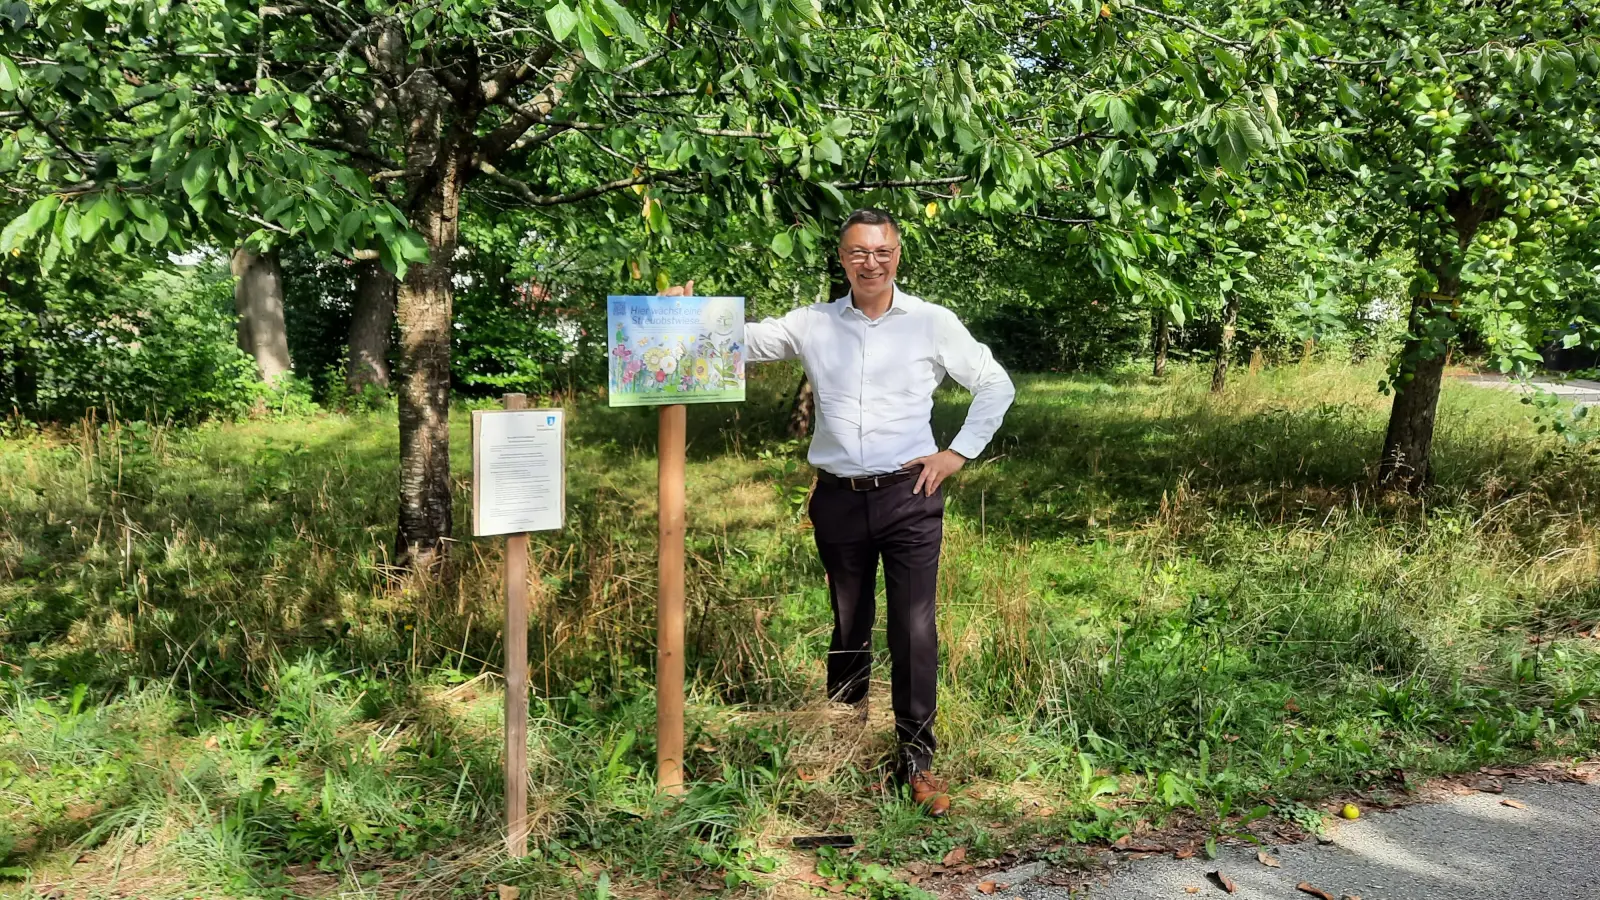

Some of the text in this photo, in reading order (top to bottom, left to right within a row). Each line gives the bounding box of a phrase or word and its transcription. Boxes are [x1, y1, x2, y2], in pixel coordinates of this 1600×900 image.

[630, 305, 702, 316] Hier wächst eine
